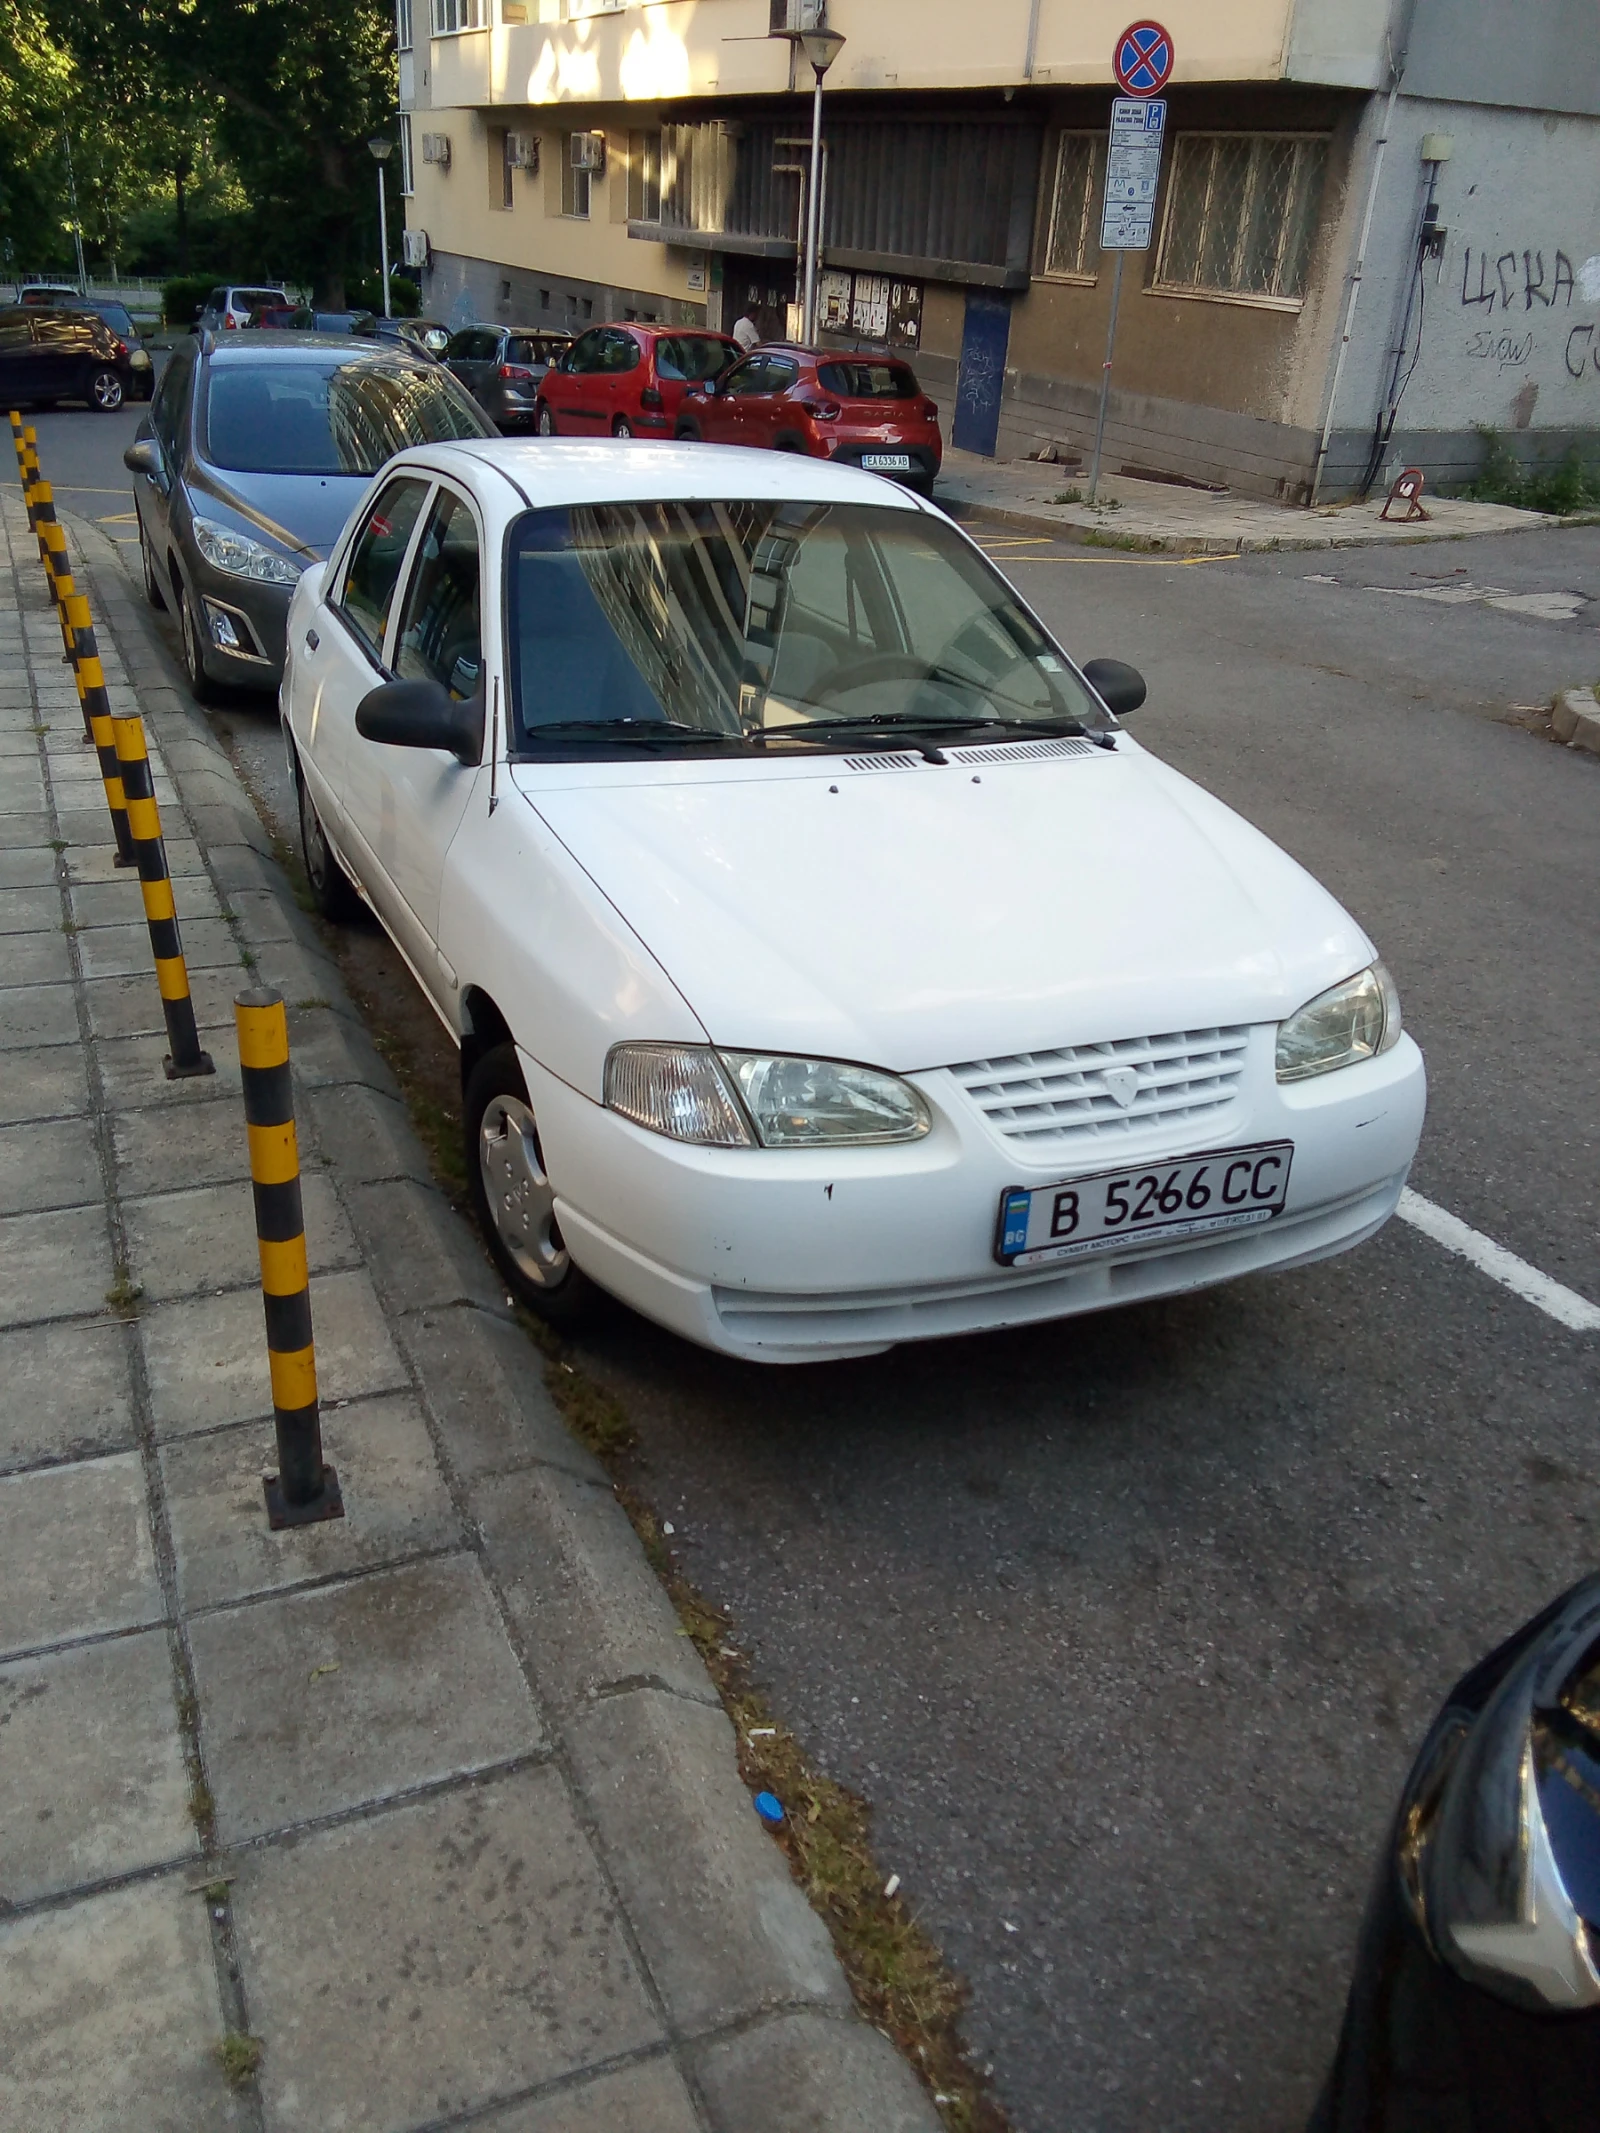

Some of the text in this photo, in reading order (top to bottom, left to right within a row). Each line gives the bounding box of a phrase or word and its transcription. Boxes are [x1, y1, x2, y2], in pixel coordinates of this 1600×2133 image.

[1152, 106, 1158, 117] P
[1462, 247, 1574, 315] ЦСКА
[867, 455, 878, 466] EA
[1050, 1156, 1282, 1238] B 5266 CC
[1004, 1230, 1026, 1246] BG
